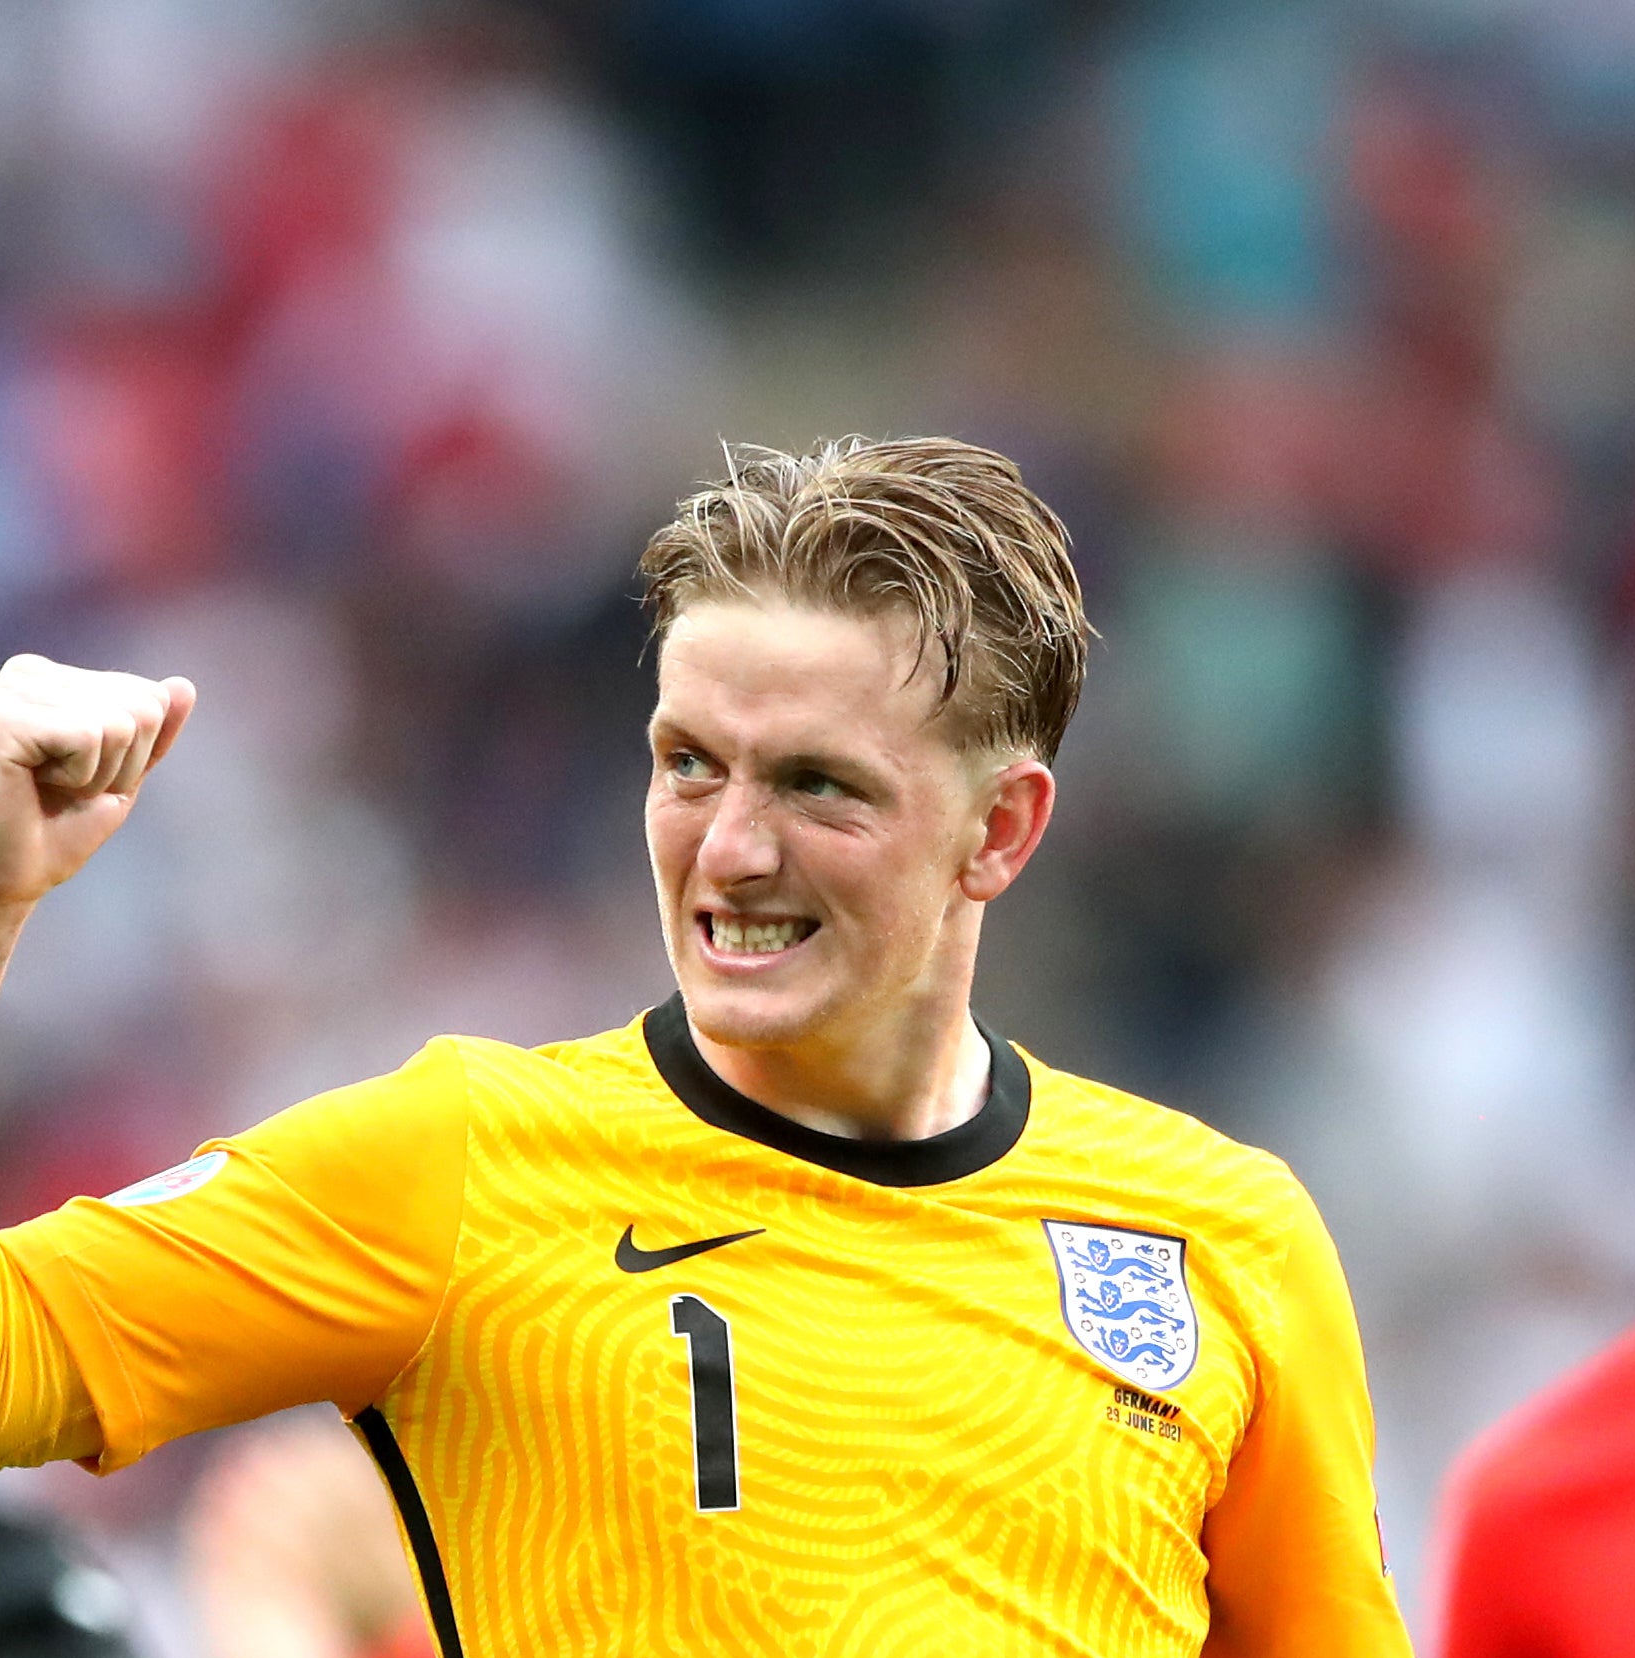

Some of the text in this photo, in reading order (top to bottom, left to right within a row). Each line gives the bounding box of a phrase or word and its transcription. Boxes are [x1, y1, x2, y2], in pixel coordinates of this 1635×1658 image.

[670, 1293, 741, 1512] 1
[1114, 1388, 1181, 1420] GERMANY
[1106, 1406, 1181, 1443] 29 JUNE 2021
